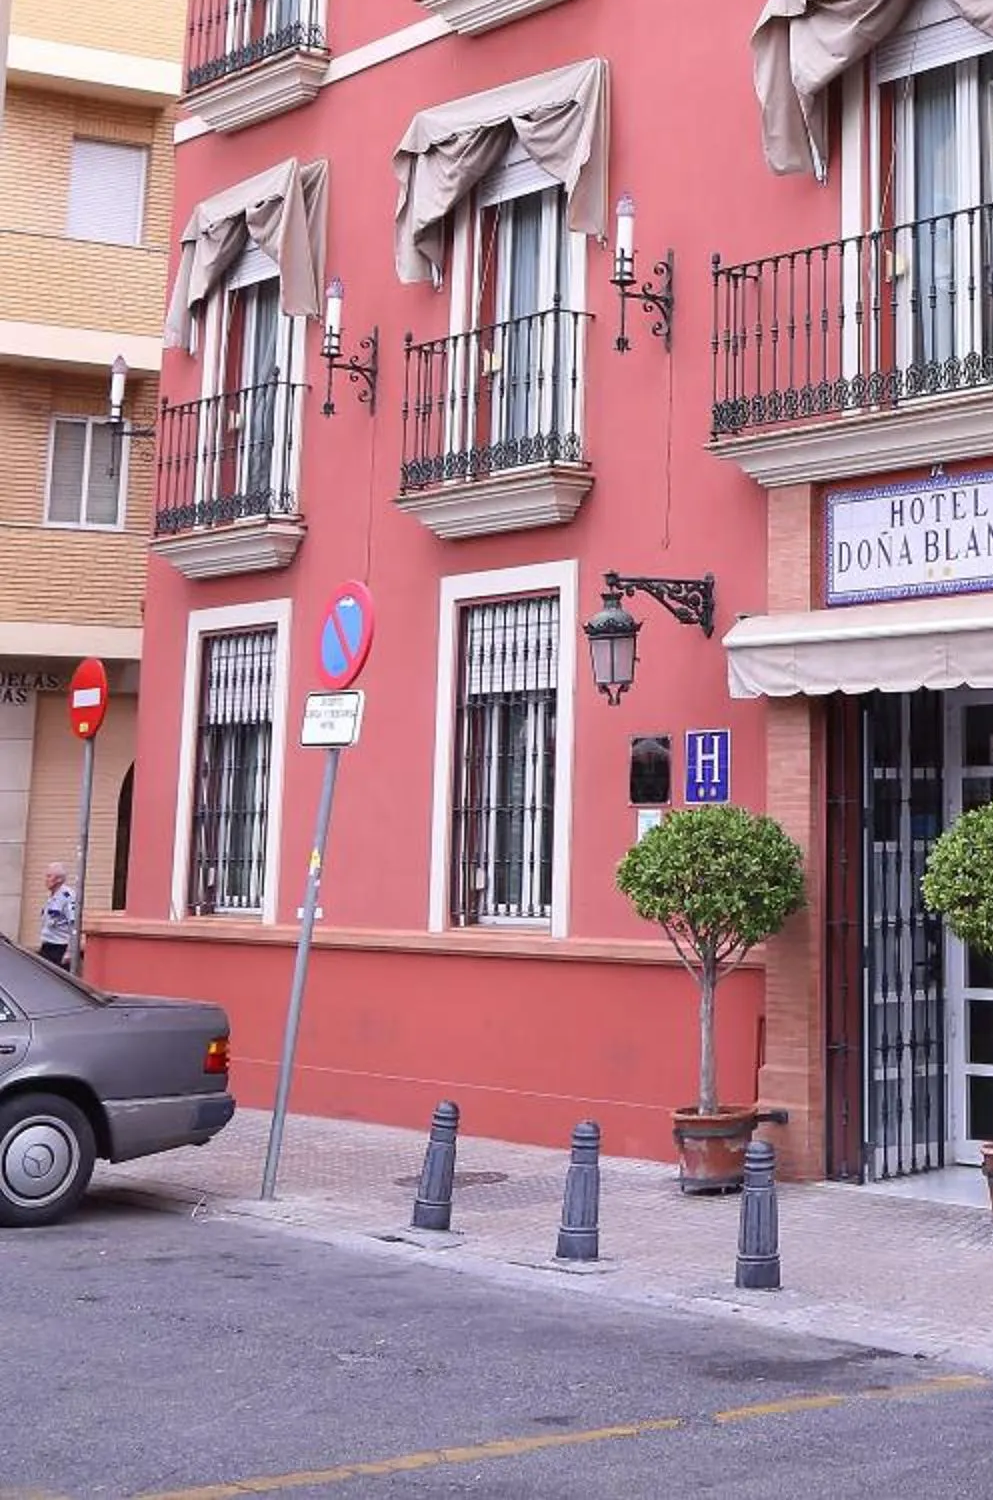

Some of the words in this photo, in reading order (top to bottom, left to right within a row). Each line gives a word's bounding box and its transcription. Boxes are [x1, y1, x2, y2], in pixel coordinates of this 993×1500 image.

[890, 488, 989, 529] HOTEL
[837, 531, 913, 573] DOÑA
[695, 735, 721, 783] H
